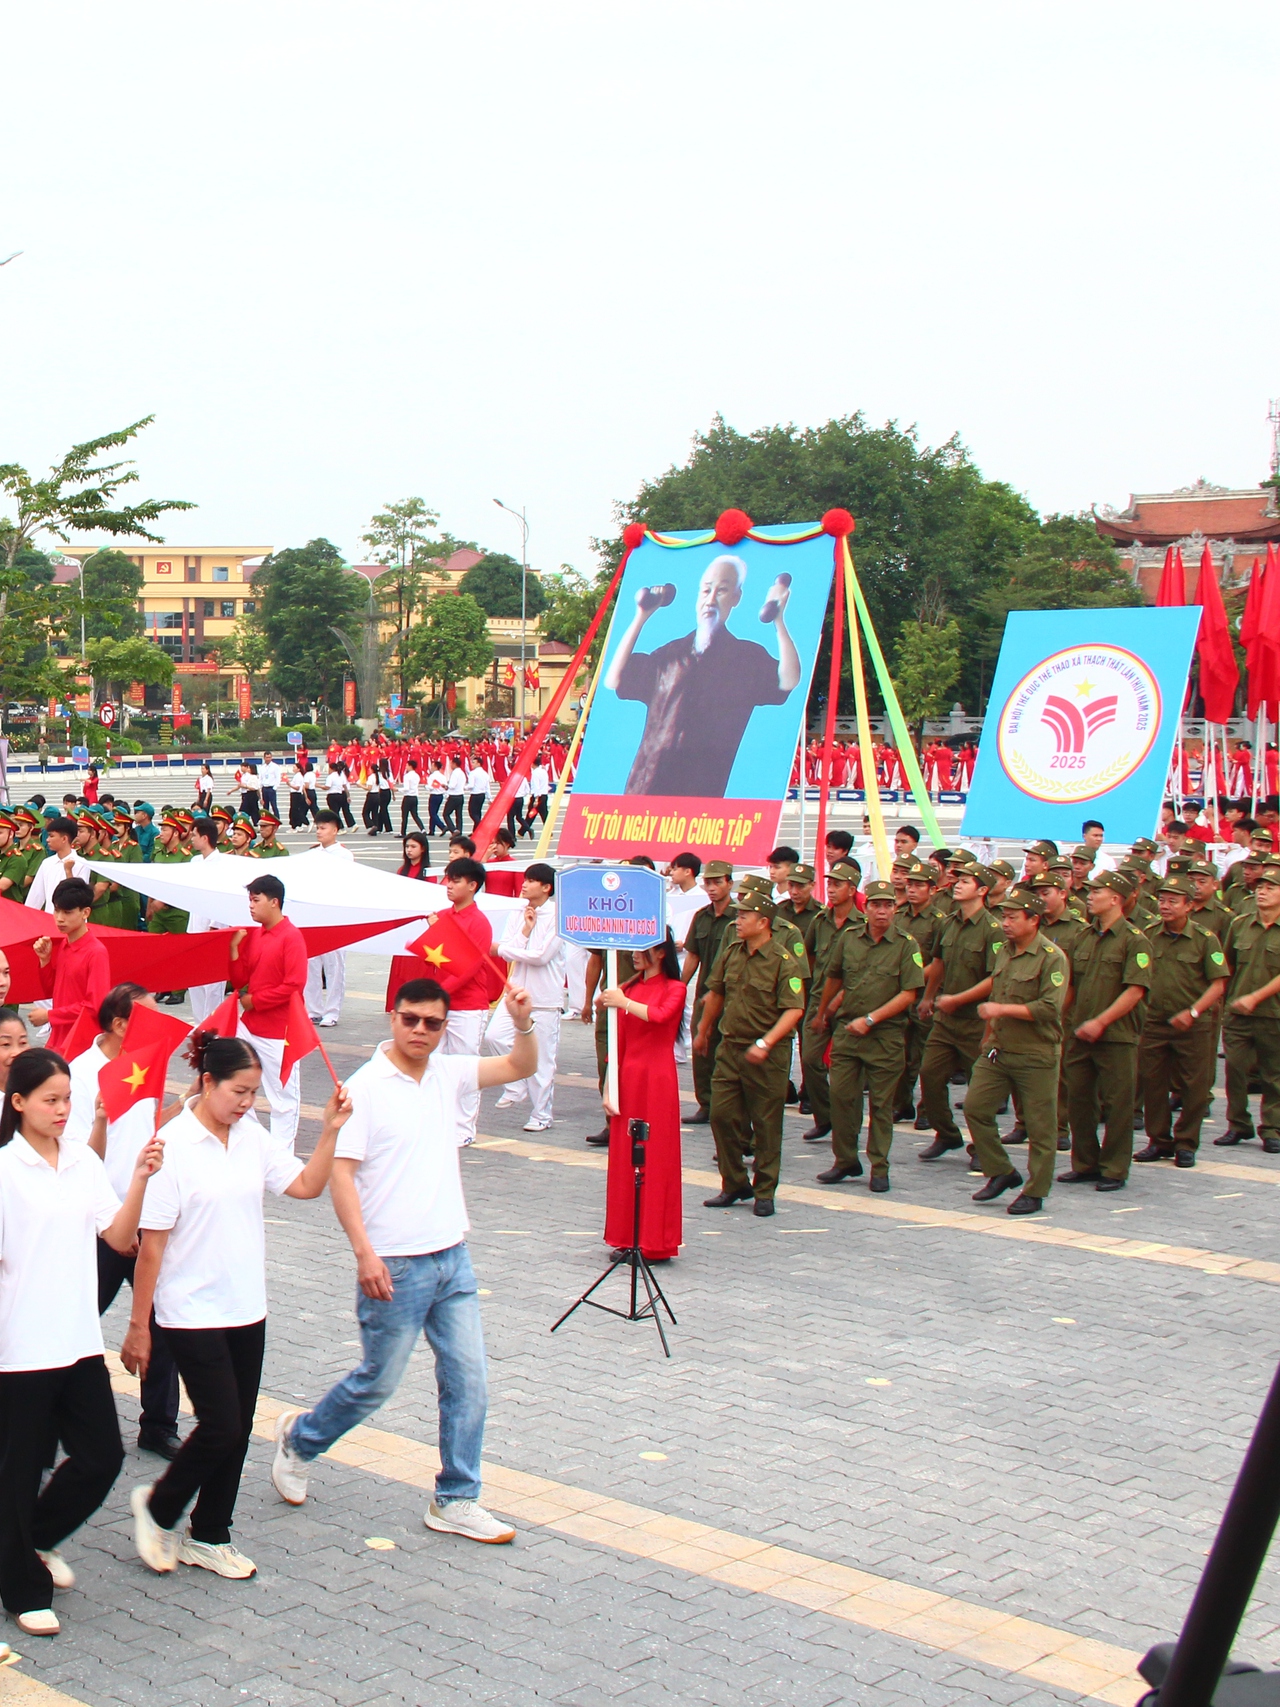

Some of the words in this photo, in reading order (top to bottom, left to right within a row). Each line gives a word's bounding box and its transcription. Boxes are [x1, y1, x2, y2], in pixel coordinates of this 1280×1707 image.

[1051, 659, 1070, 675] THAO
[1083, 655, 1107, 668] THẠCH
[1025, 680, 1040, 696] DỤC
[1010, 708, 1024, 721] HỘI
[1135, 713, 1149, 731] 2025
[1008, 722, 1021, 734] ĐẠI
[1049, 755, 1087, 769] 2025
[581, 806, 602, 845] “TỰ
[601, 809, 622, 841] TÔI
[621, 810, 659, 842] NGÀY
[657, 811, 687, 844] NÀO
[687, 812, 724, 846] CŨNG
[725, 812, 762, 852] TẬP”
[588, 892, 633, 912] KHỐI
[565, 915, 578, 934] LỰC
[579, 915, 600, 936] LƯỢNG
[602, 917, 611, 932] AN
[625, 918, 636, 937] TẠI
[637, 918, 646, 935] CƠ
[647, 915, 656, 936] SỞ
